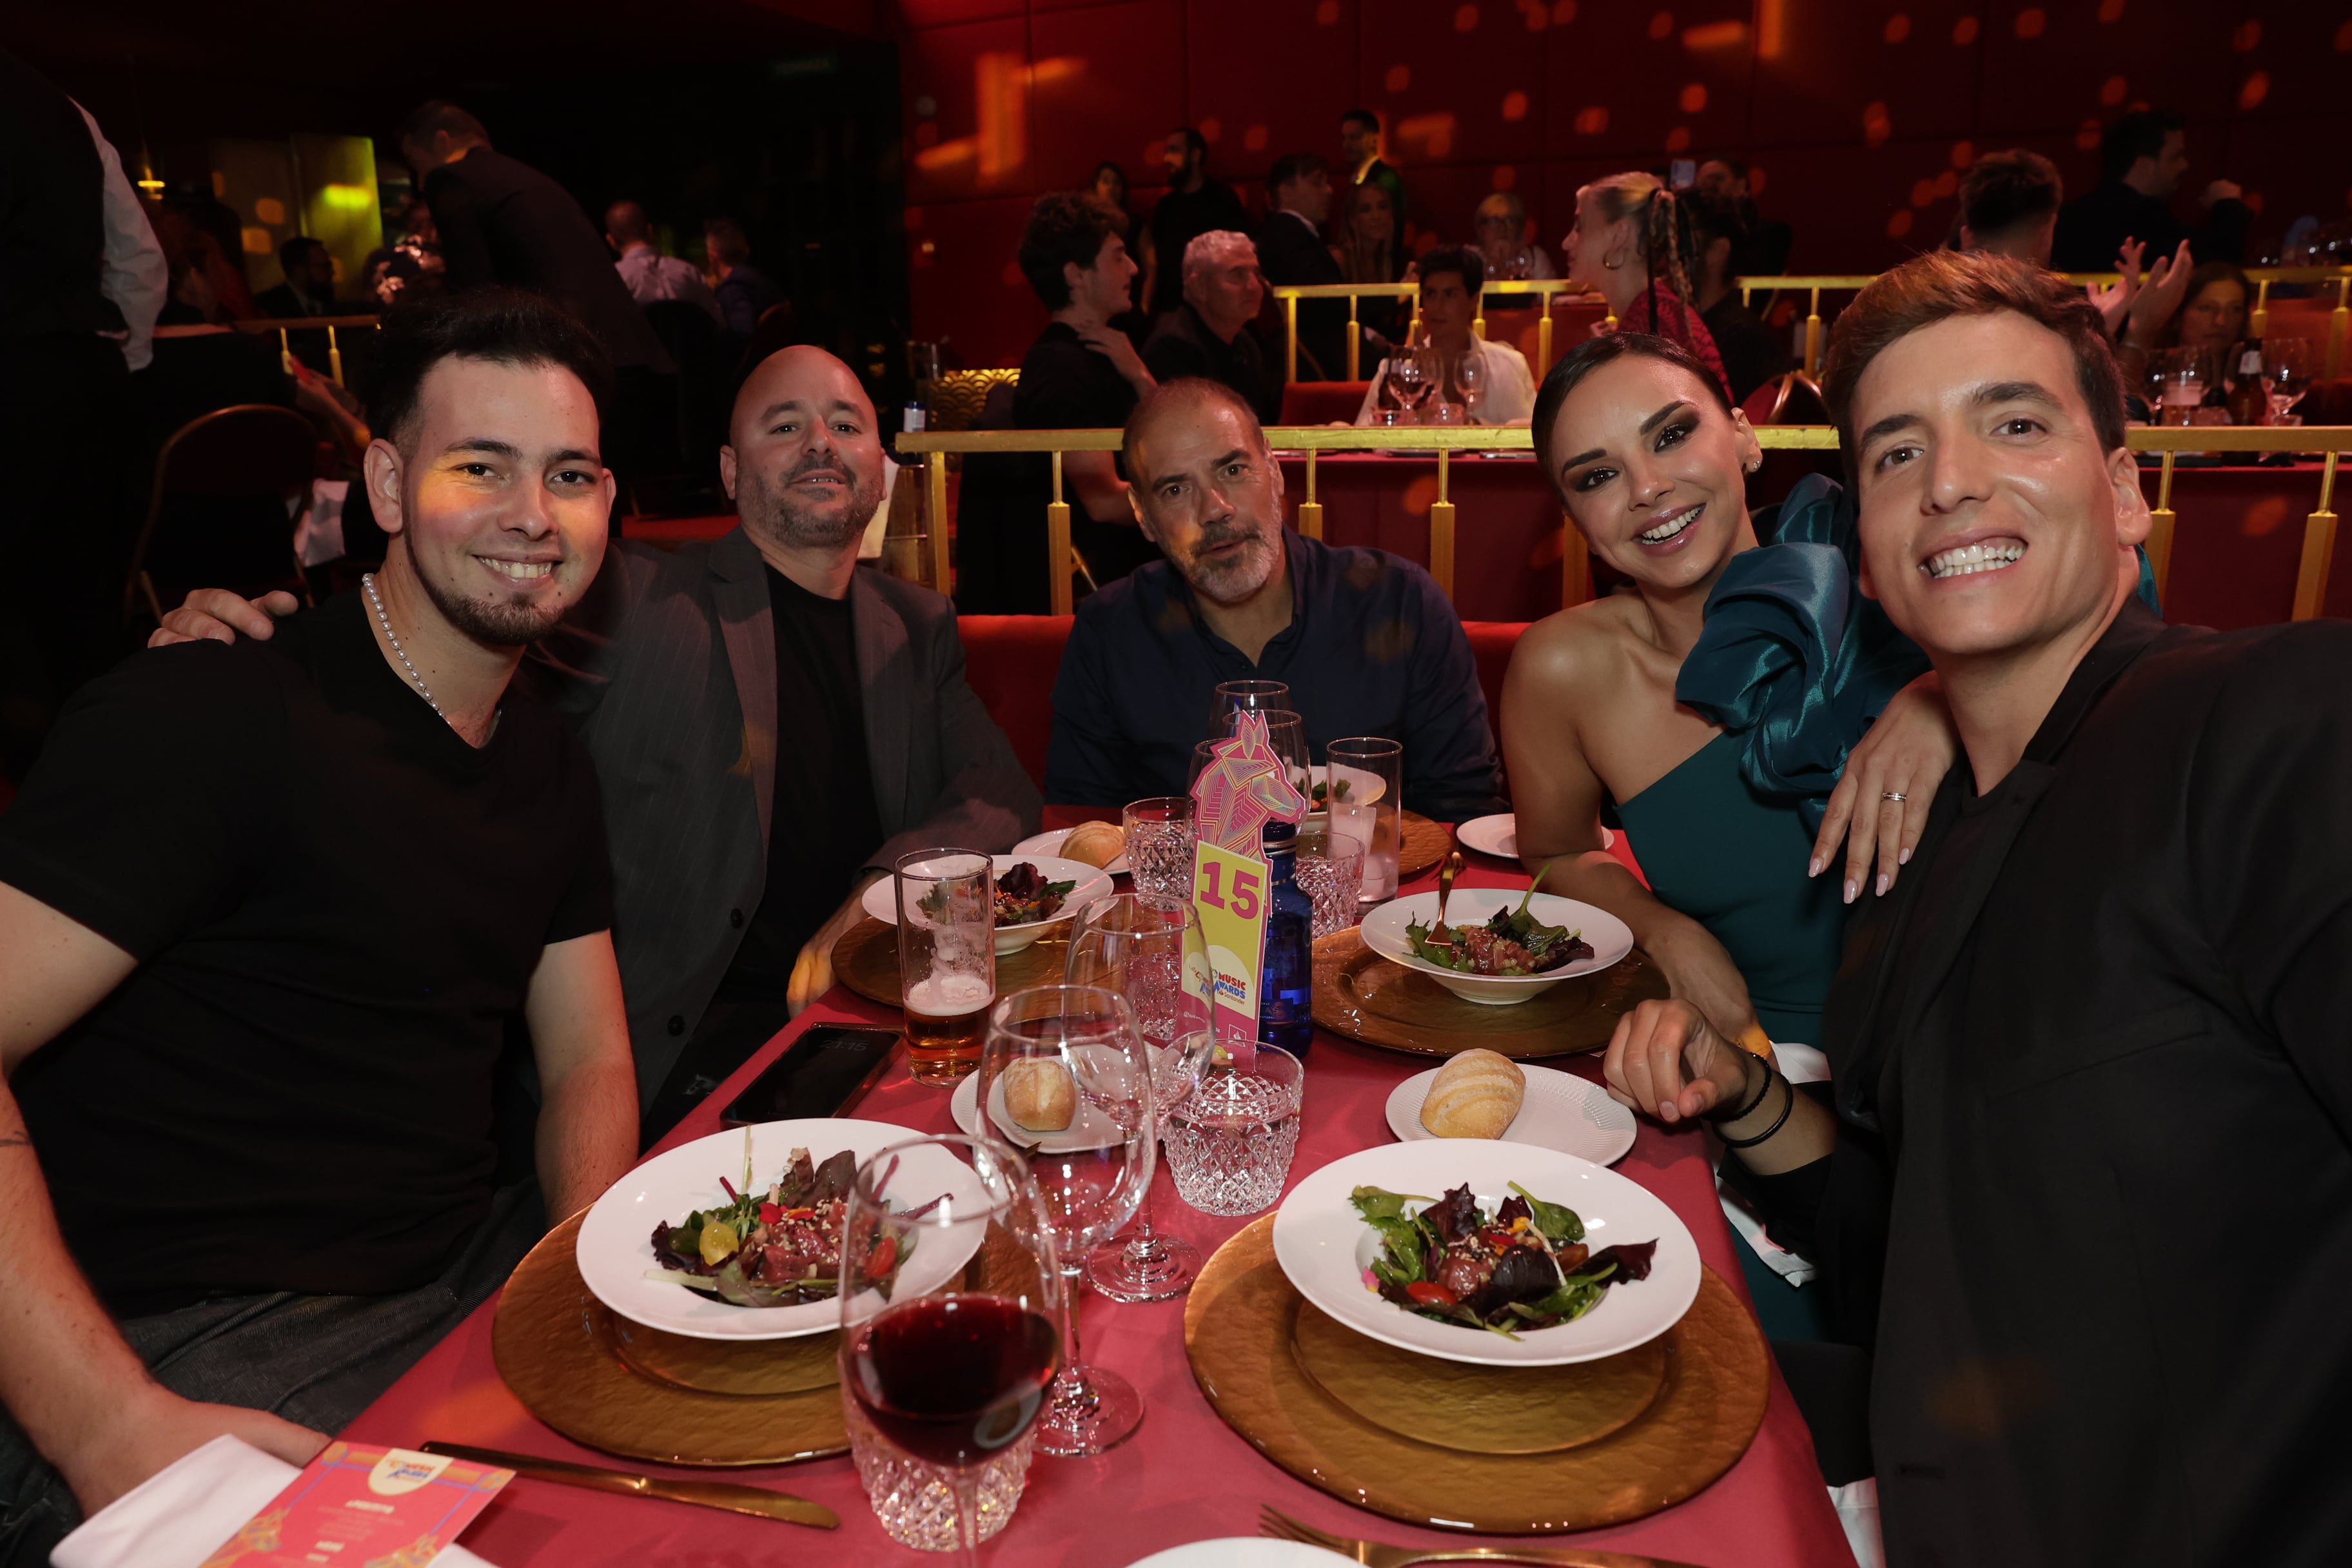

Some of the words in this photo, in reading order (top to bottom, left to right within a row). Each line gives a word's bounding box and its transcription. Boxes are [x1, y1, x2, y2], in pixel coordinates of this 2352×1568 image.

[1200, 861, 1259, 919] 15
[1213, 979, 1246, 999] AWARDS
[1219, 972, 1246, 991] MUSIC
[1224, 992, 1246, 1006] Santander
[819, 1039, 868, 1051] 21:15
